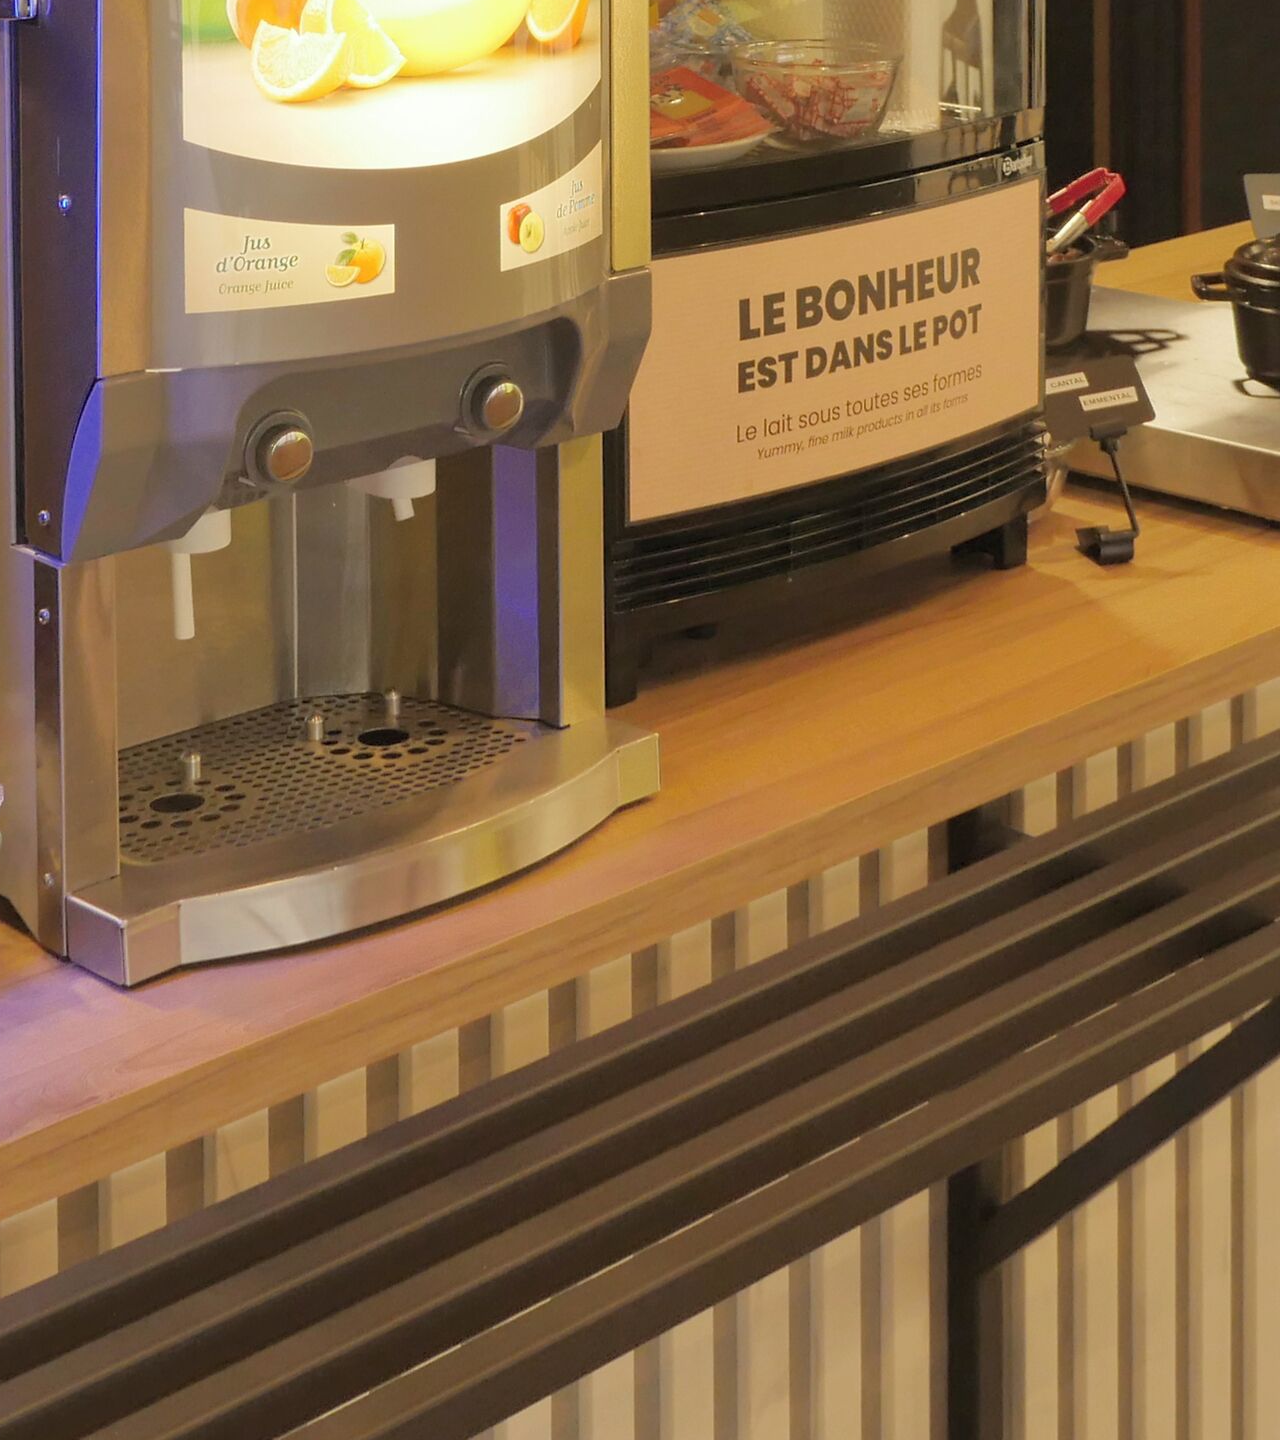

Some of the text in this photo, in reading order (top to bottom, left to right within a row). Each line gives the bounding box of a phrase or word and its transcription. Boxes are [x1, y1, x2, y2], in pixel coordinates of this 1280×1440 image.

[570, 180, 583, 198] Jus
[557, 204, 567, 218] de
[240, 236, 271, 255] Jus
[216, 255, 299, 273] d'Orange
[219, 280, 294, 295] Orange Juice
[738, 247, 980, 341] LE BONHEUR
[738, 303, 982, 393] EST DANS LE POT
[1050, 376, 1086, 388] CANTAL
[736, 364, 982, 443] Le lait sous toutes ses formes
[1083, 392, 1132, 406] EMMENTAL
[757, 393, 968, 460] Yummy, fine milk products in all its forms
